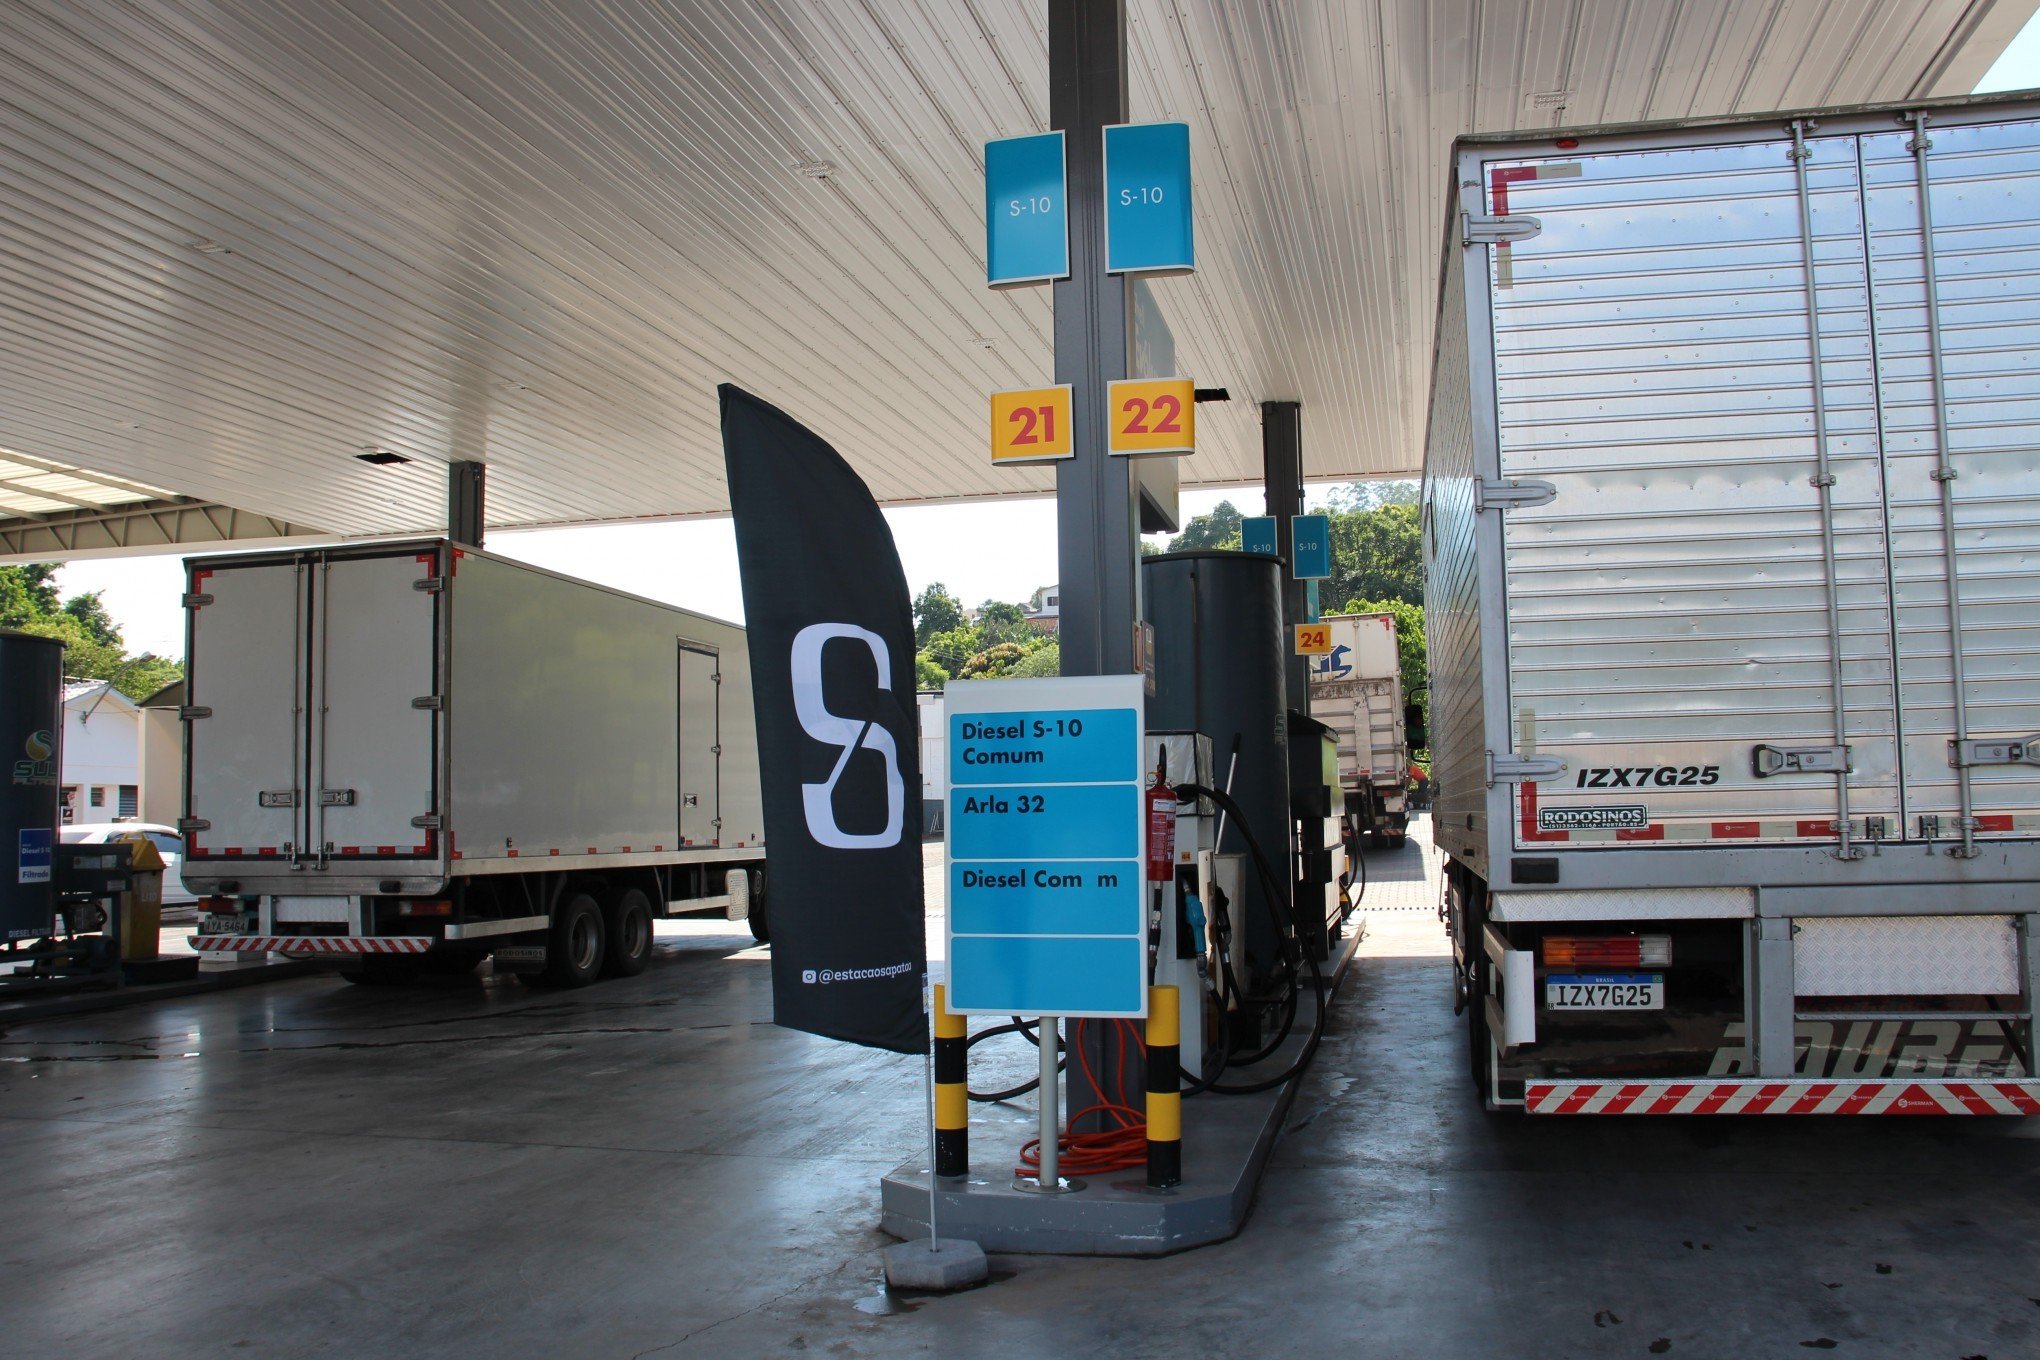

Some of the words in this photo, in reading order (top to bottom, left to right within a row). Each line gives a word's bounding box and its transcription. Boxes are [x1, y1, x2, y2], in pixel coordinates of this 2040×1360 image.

[1120, 186, 1163, 206] S-10
[1009, 197, 1051, 217] S-10
[1121, 394, 1181, 434] 22
[1009, 405, 1055, 446] 21
[1253, 544, 1271, 552] S-10
[1299, 543, 1317, 551] S-10
[1300, 631, 1325, 648] 24
[962, 719, 1025, 740] Diesel
[1032, 718, 1083, 738] S-10
[962, 747, 1044, 765] Comum
[1576, 766, 1720, 788] IZX7G25
[963, 795, 1008, 814] Arla
[1016, 795, 1045, 813] 32
[1544, 810, 1641, 824] RODOSINOS
[963, 869, 1026, 888] Diesel
[1556, 985, 1652, 1006] IZX7G25
